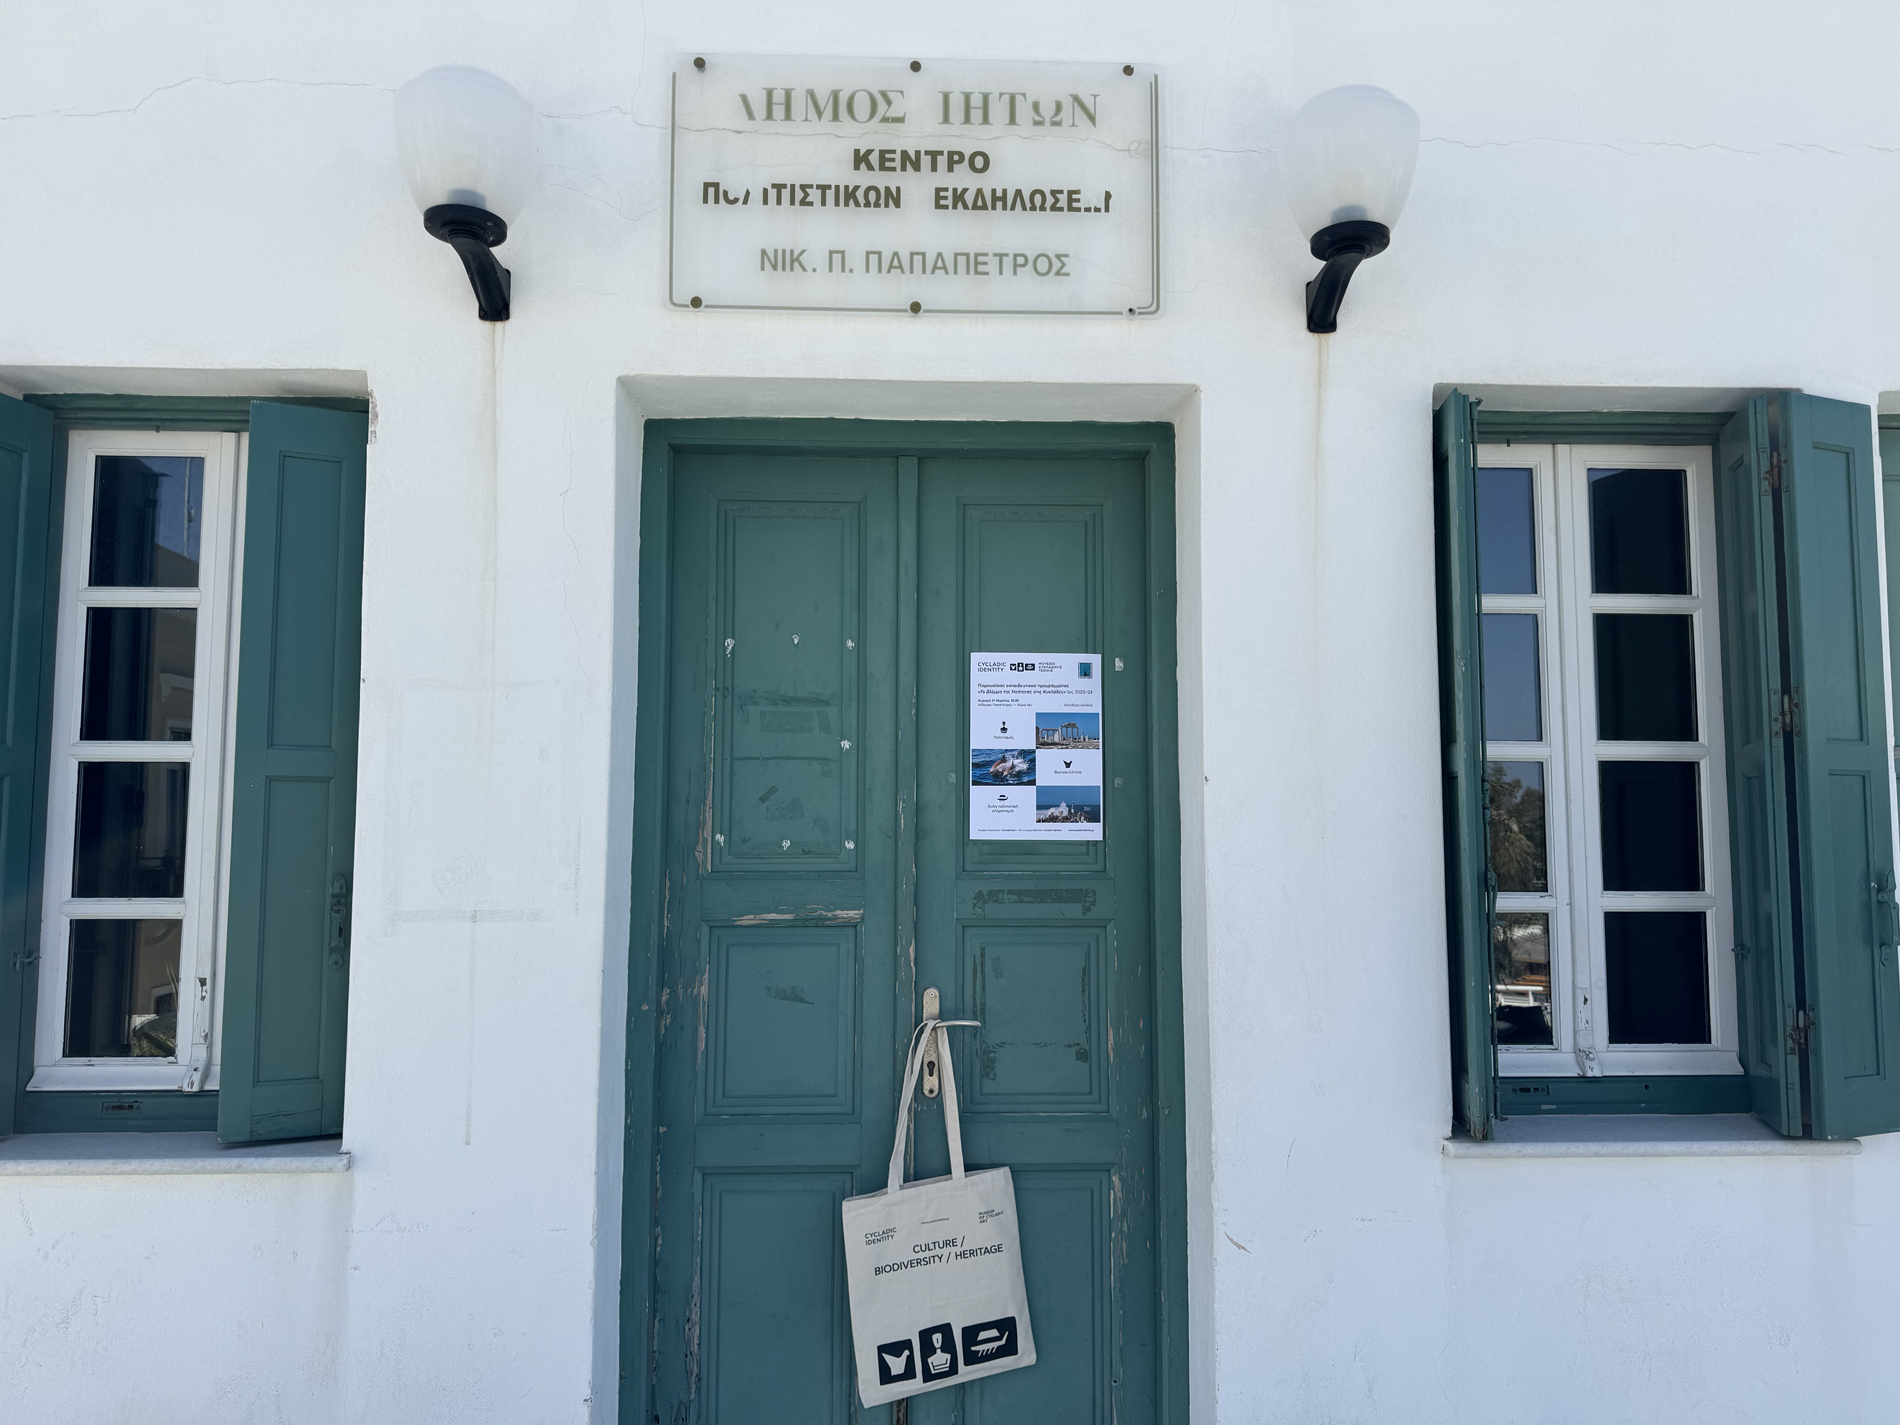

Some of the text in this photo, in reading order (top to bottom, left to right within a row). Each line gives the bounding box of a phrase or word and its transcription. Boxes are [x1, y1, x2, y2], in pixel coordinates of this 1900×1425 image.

[938, 90, 1100, 129] ΙΗΤΩΝ
[853, 148, 991, 174] ΚΕΝΤΡΟ
[934, 187, 1112, 214] ΕΚΔΗΛΩΣΕ
[760, 248, 1071, 278] ΝΙΚ. Π. ΠΑΠΑΠΕΤΡΟΣ
[985, 1210, 1004, 1219] CYCLADIC
[864, 1227, 897, 1239] CYCLADIC
[865, 1234, 895, 1246] IDENTITY
[912, 1236, 966, 1254] CULTURE /
[874, 1243, 1004, 1276] BIODIVERSITY / HERITAGE
